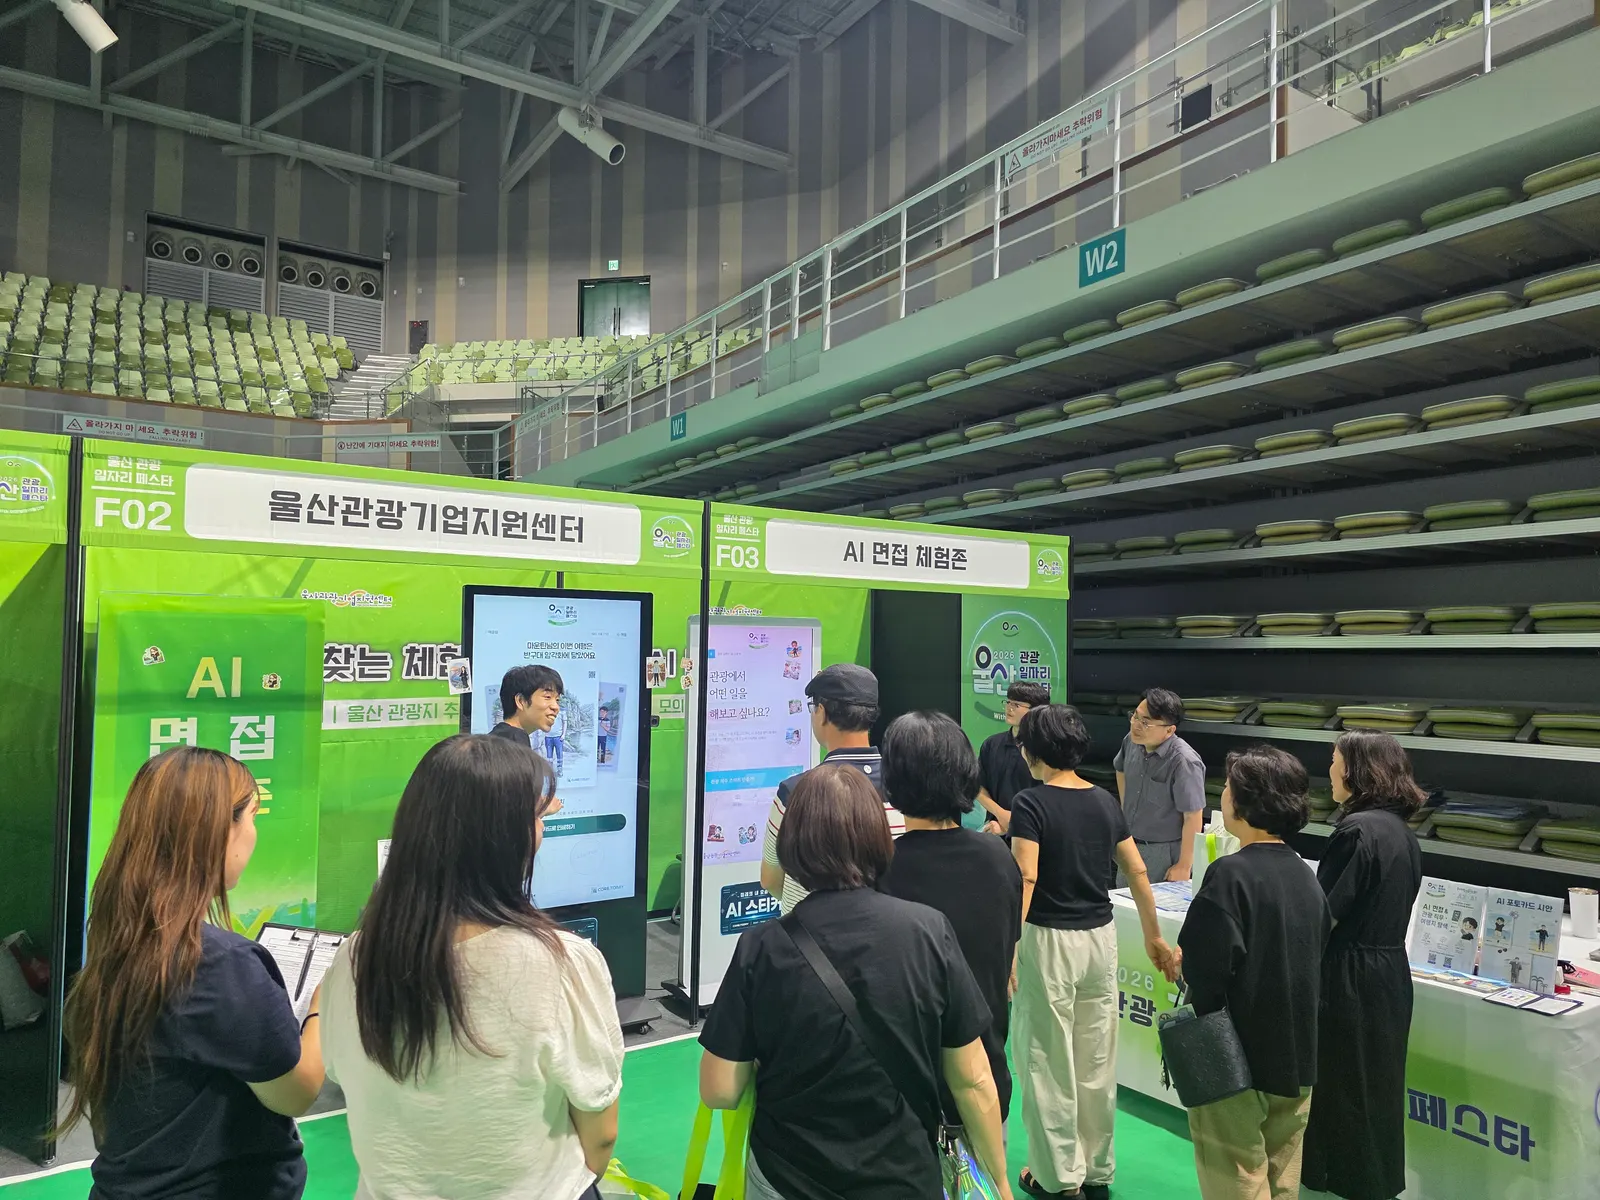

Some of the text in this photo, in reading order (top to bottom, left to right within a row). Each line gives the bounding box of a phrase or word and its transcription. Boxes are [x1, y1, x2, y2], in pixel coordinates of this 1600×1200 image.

[1086, 240, 1118, 277] W2
[672, 417, 684, 436] W1
[108, 456, 133, 468] 울산
[94, 470, 174, 487] 일자리 페스타
[95, 496, 172, 531] F02
[269, 490, 584, 544] 울산관광기업지원센터
[717, 524, 737, 535] 일자리
[717, 544, 759, 569] F03
[843, 541, 967, 570] AI 면접 체험존
[324, 644, 391, 680] 찾는
[993, 651, 1015, 660] 2026
[1019, 651, 1040, 663] 관광
[186, 656, 242, 698] AI
[709, 670, 746, 683] 관광에서
[709, 687, 748, 700] 어떤 일을
[347, 705, 383, 722] 울산
[388, 703, 438, 720] 관광지
[709, 706, 770, 720] 해보고 싶나요?
[725, 897, 782, 919] AI 스티커
[1496, 897, 1553, 913] AI 포토카드 시안
[1117, 967, 1154, 992] 026
[1407, 1087, 1535, 1162] 페스타
